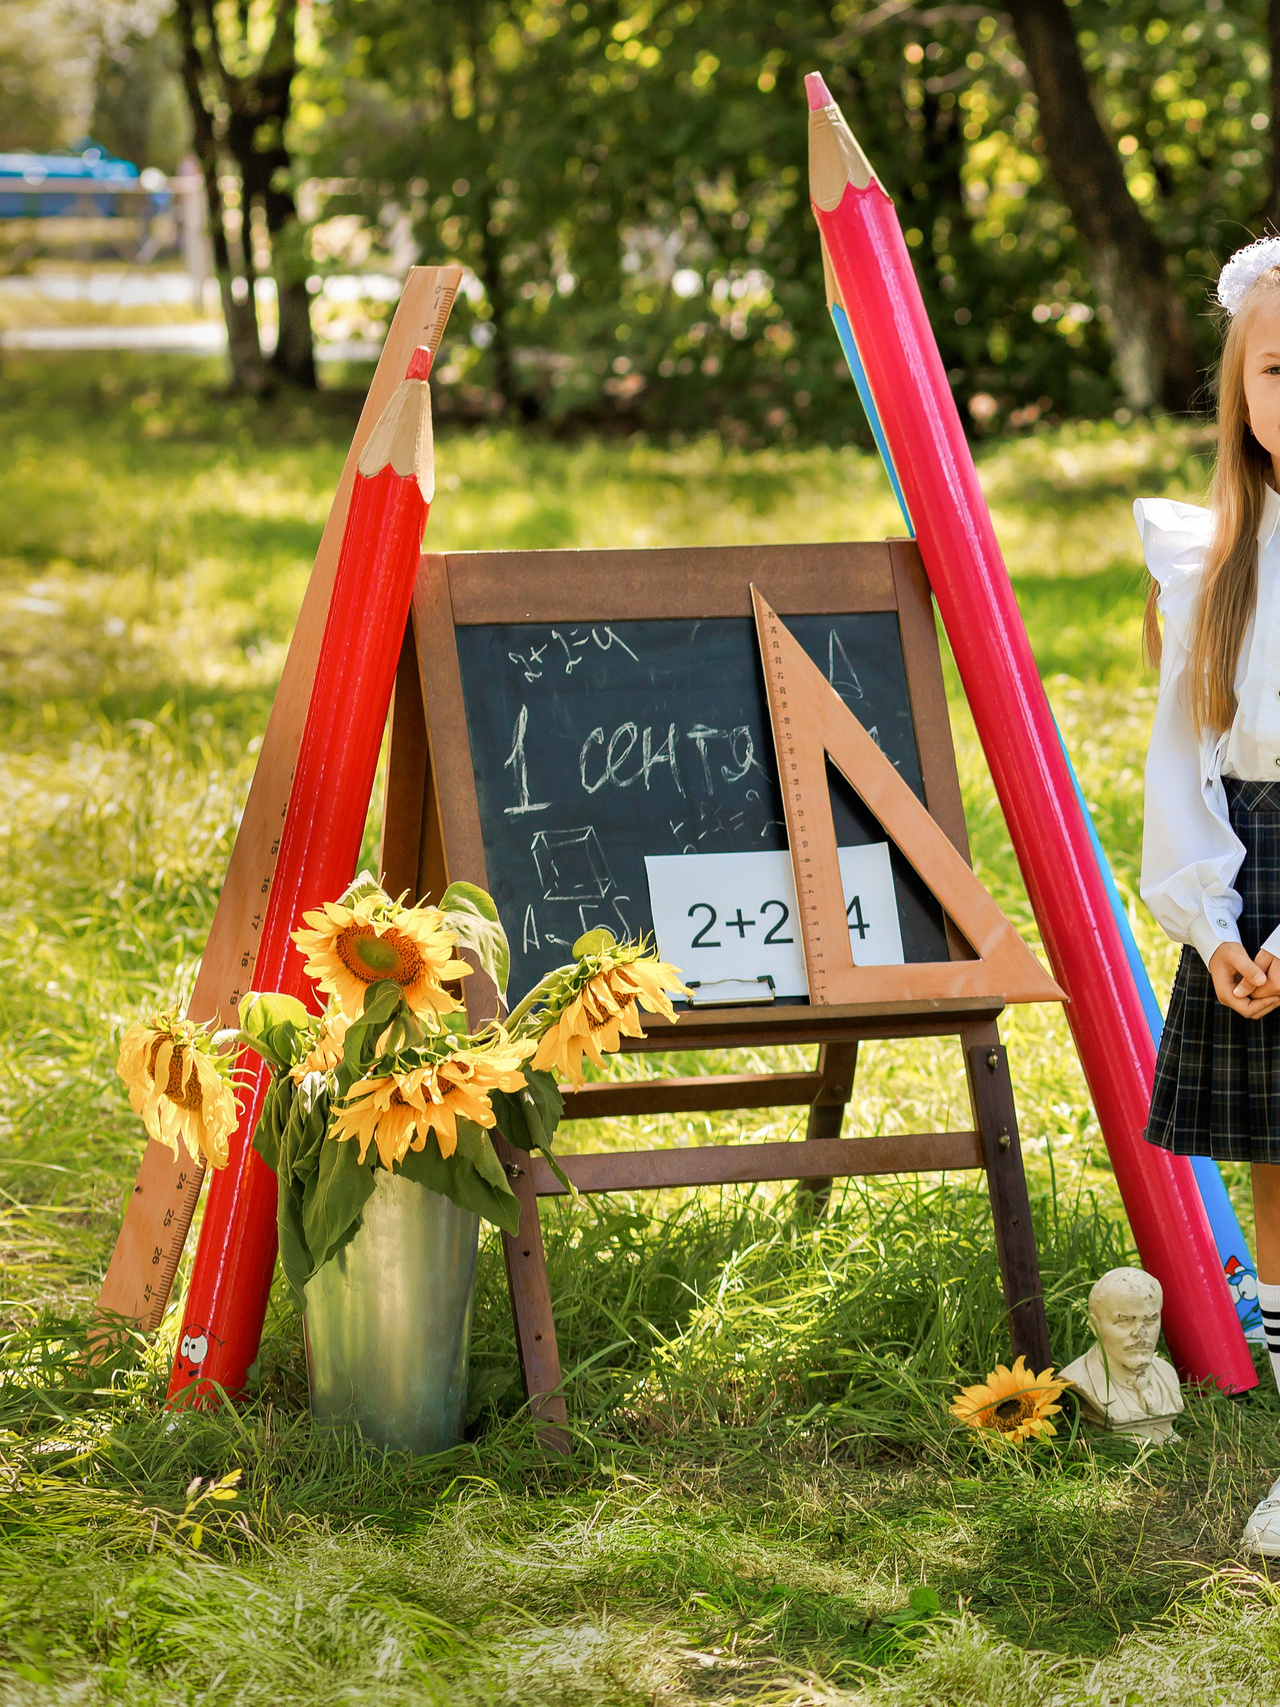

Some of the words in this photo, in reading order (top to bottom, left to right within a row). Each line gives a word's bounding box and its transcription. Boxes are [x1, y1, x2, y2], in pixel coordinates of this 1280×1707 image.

[509, 626, 639, 683] 2+2=4
[504, 704, 551, 813] 1
[271, 838, 280, 855] 15
[261, 876, 270, 893] 16
[251, 913, 260, 930] 17
[688, 895, 870, 948] 2+24
[241, 950, 250, 967] 18
[229, 988, 239, 1005] 19
[176, 1172, 187, 1190] 24
[163, 1208, 174, 1227] 25
[152, 1246, 162, 1265] 26
[144, 1283, 152, 1303] 27
